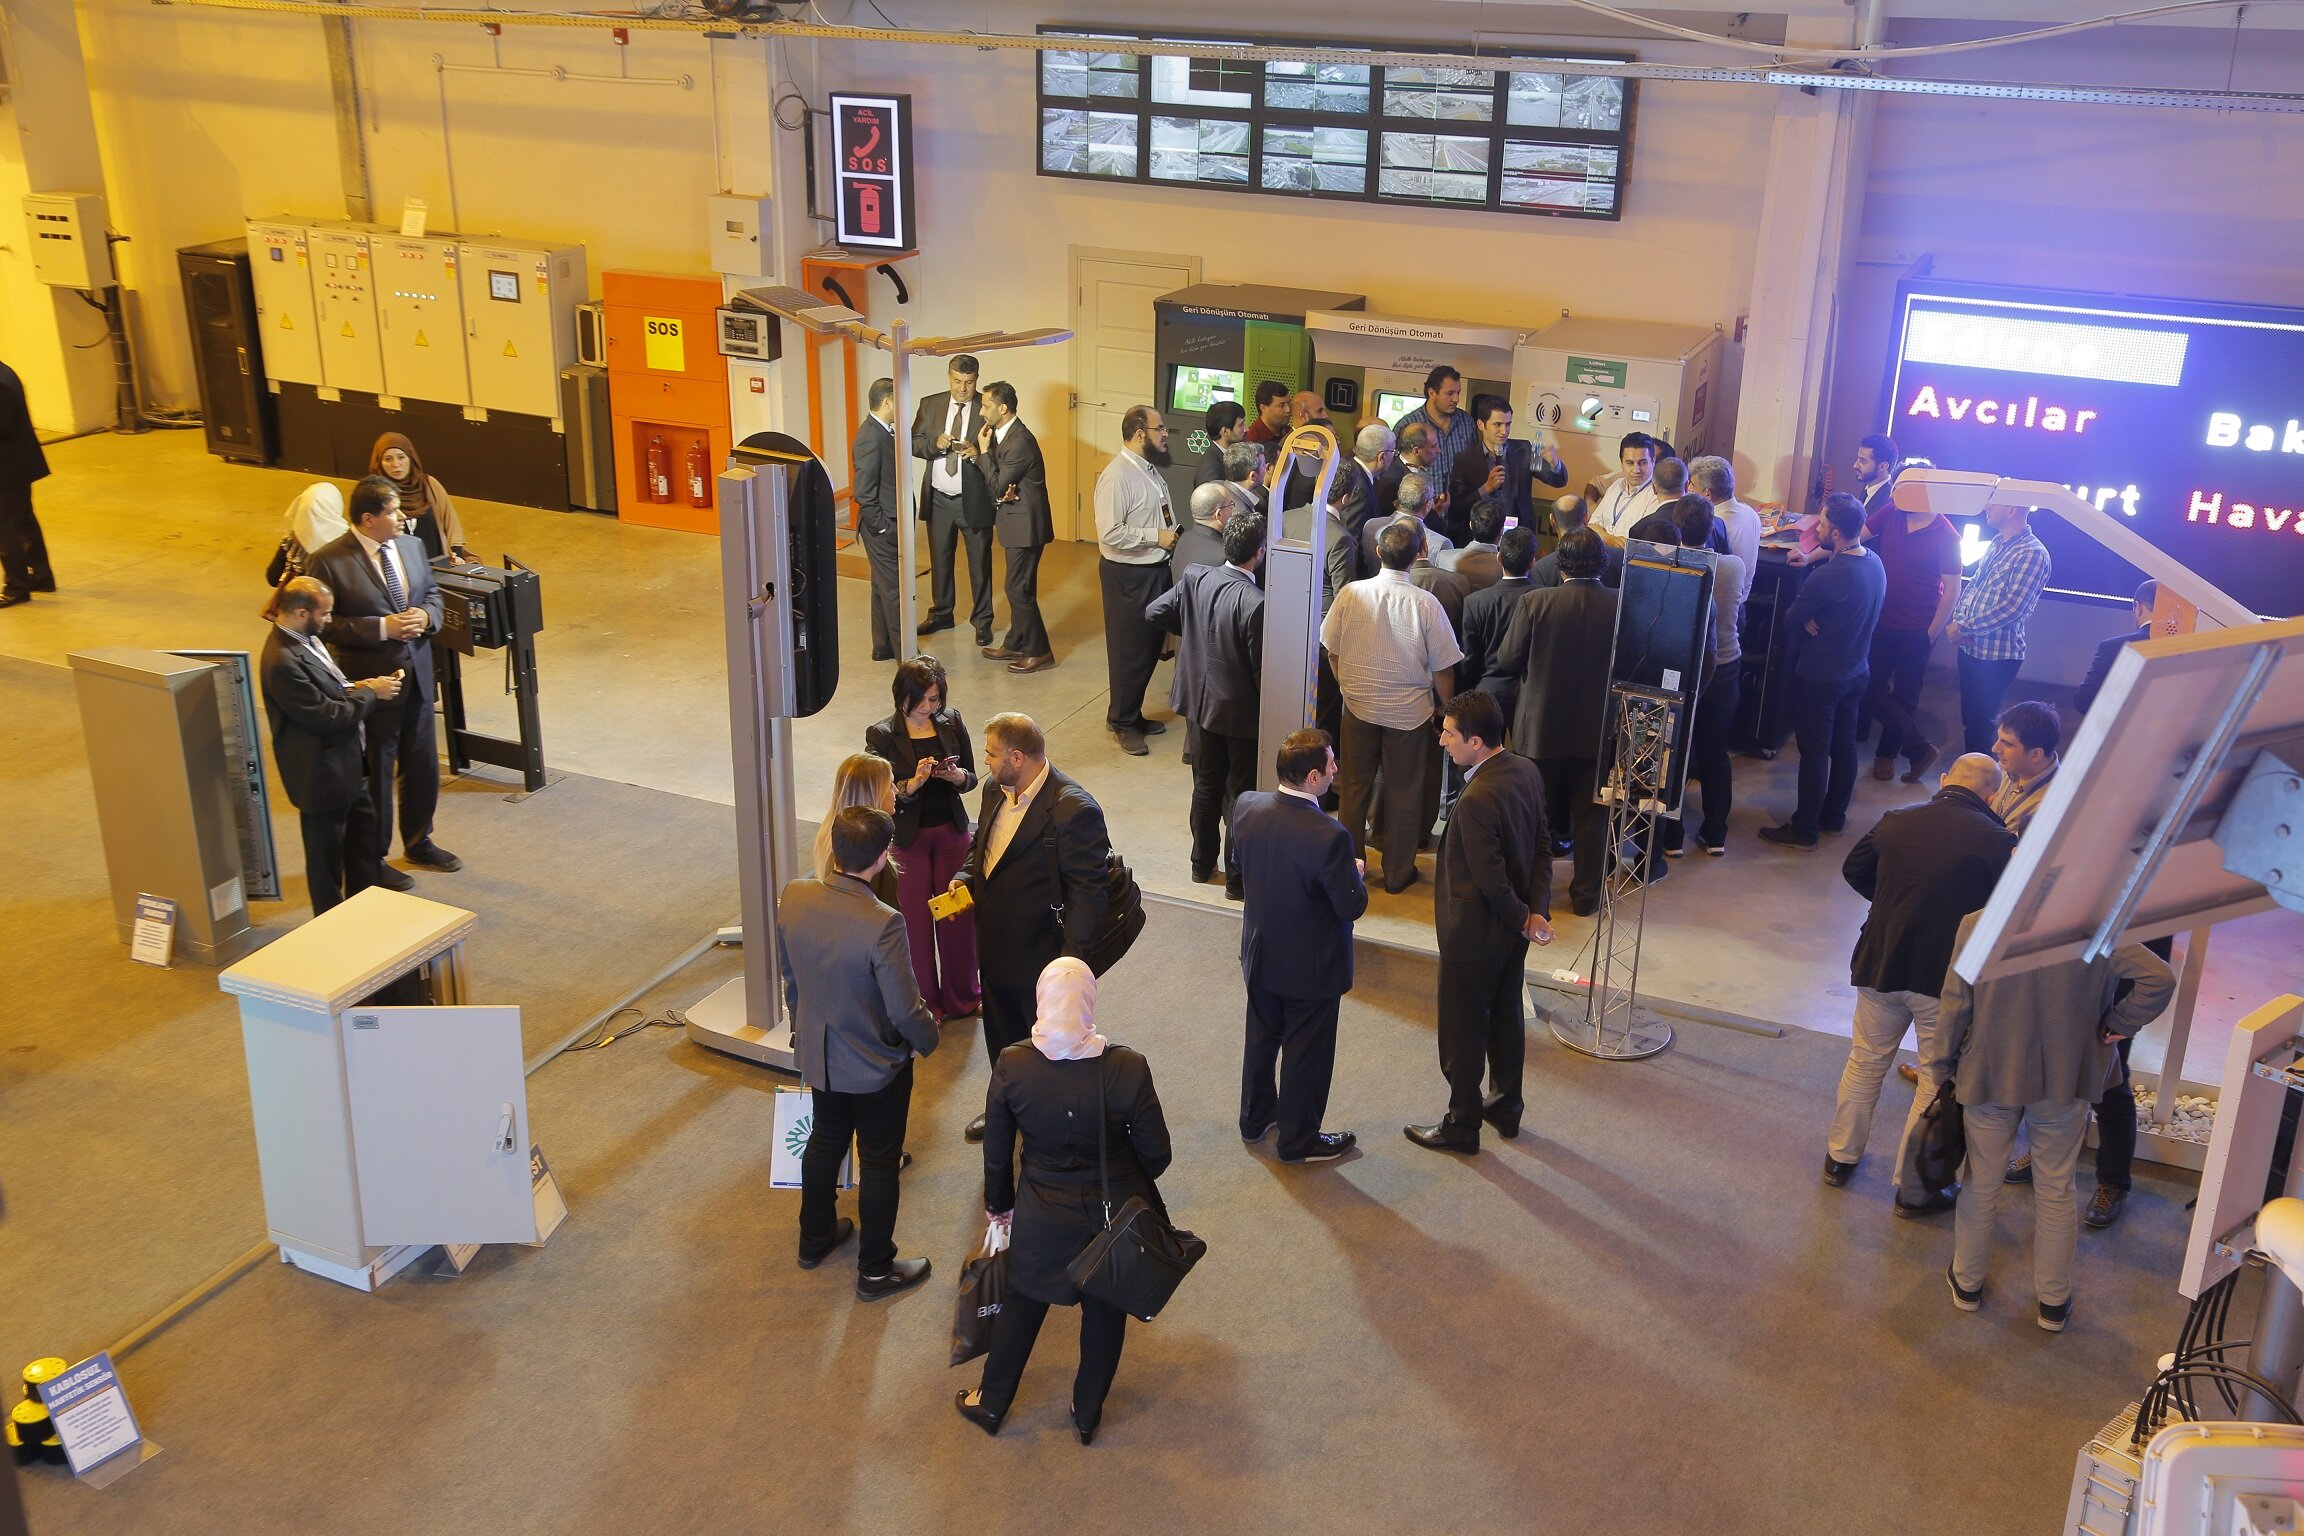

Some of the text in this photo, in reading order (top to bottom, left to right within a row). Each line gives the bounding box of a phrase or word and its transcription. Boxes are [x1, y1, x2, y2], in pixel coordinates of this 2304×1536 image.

[849, 157, 886, 172] SOS
[1183, 306, 1269, 320] Geri Dönüşüm Otomatı
[648, 321, 679, 336] SOS
[1349, 323, 1443, 339] Geri Dönüşüm Otomatı
[1908, 385, 2098, 433] Avcılar
[48, 1363, 102, 1397] KABLOSUZ
